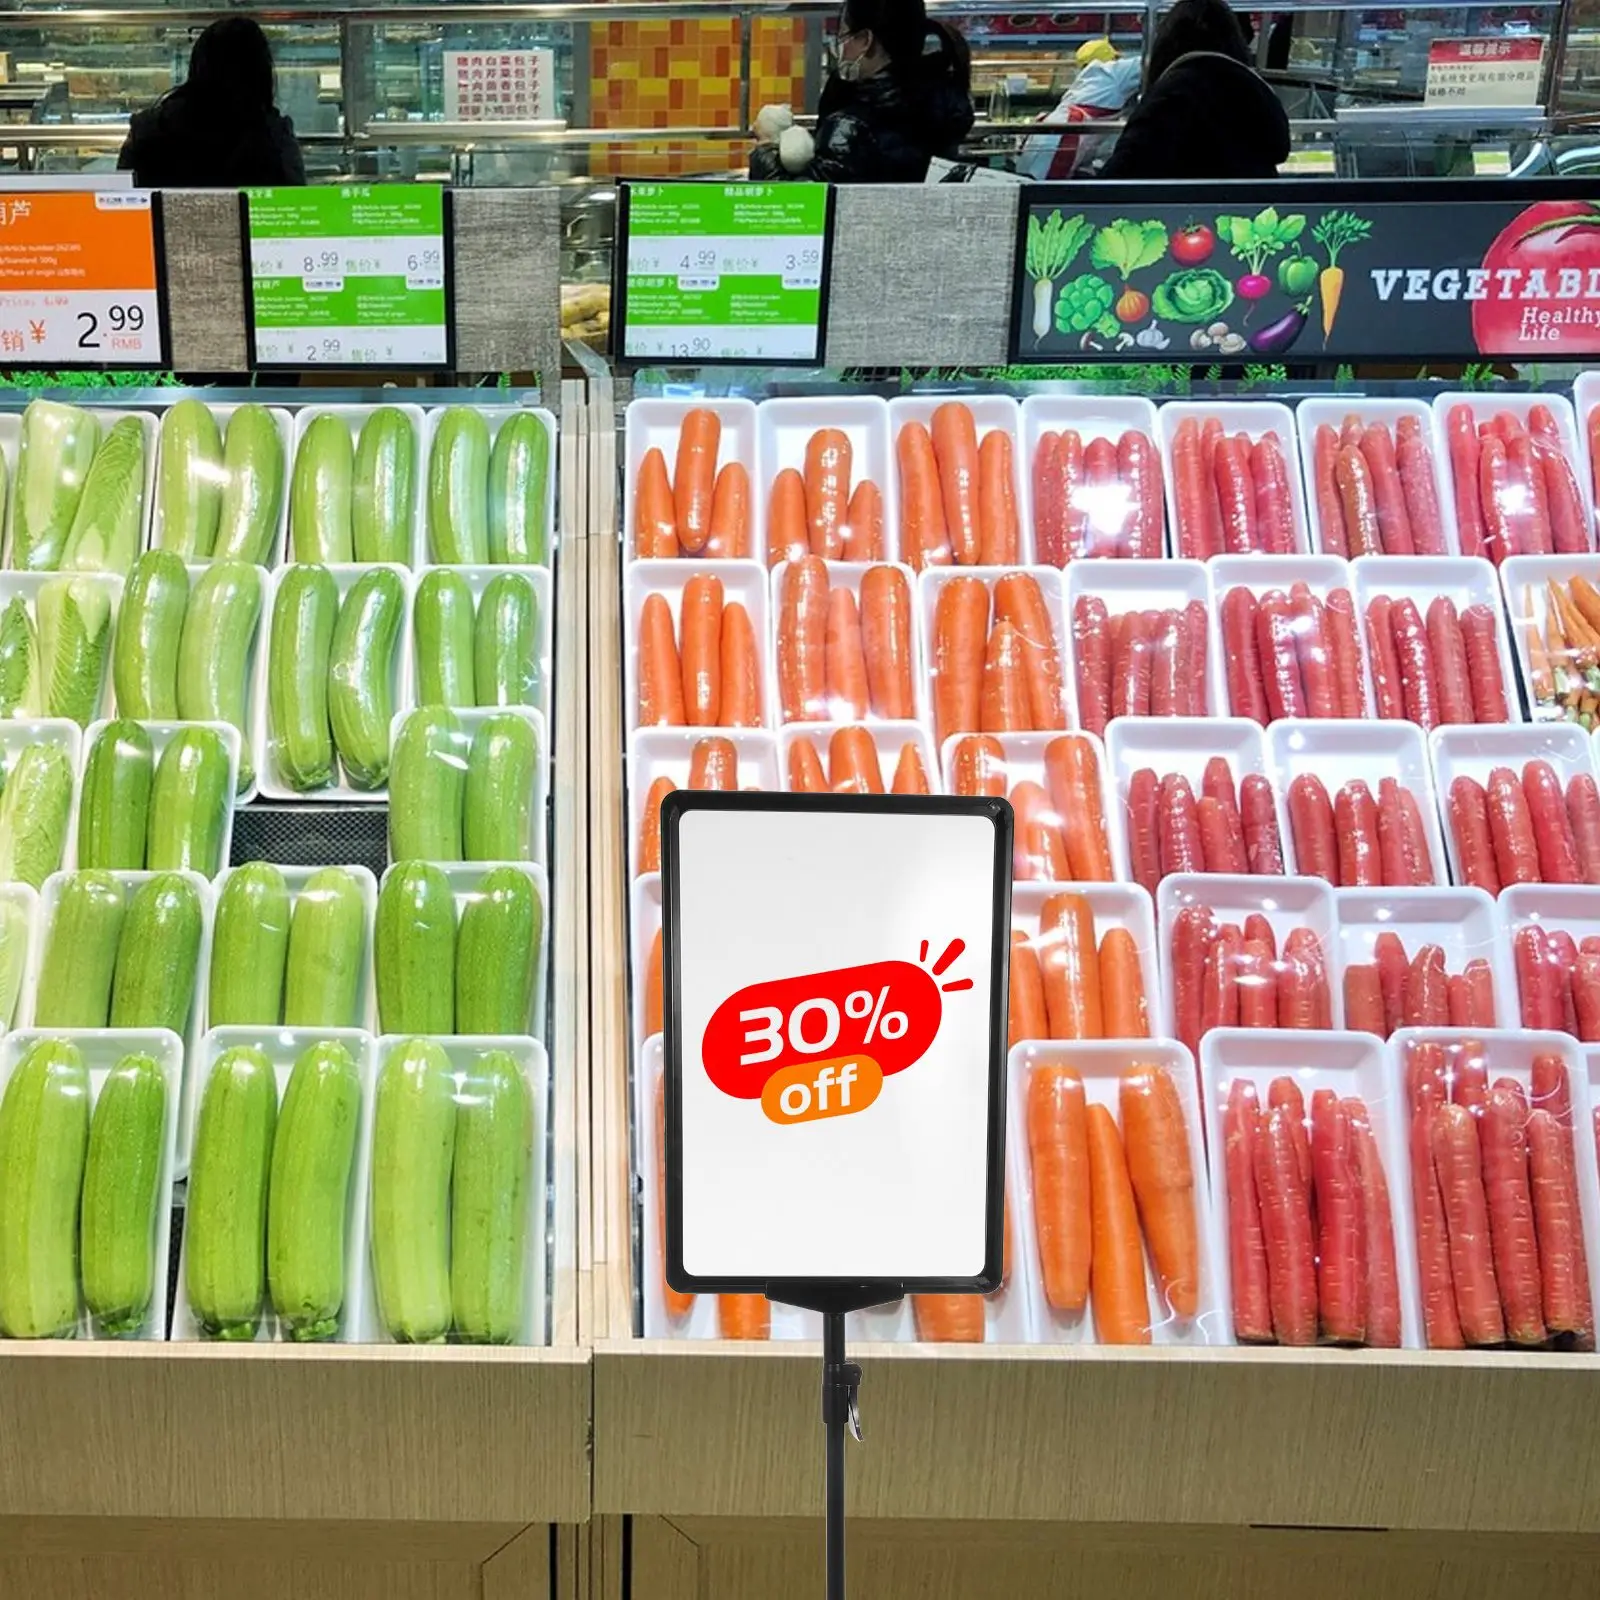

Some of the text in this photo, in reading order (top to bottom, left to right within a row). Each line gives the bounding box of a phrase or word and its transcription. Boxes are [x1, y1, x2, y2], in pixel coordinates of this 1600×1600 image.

[457, 56, 539, 67] 猪肉白菜包子
[457, 68, 539, 79] 猪肉芹菜包子
[303, 251, 339, 273] 8.99
[407, 250, 440, 272] 6.99
[679, 250, 716, 270] 4.99
[786, 250, 820, 271] 3.59
[77, 305, 145, 348] 2.99
[1519, 324, 1561, 341] Life
[111, 337, 143, 350] RMB
[739, 985, 909, 1066] 30%
[779, 1062, 858, 1117] off
